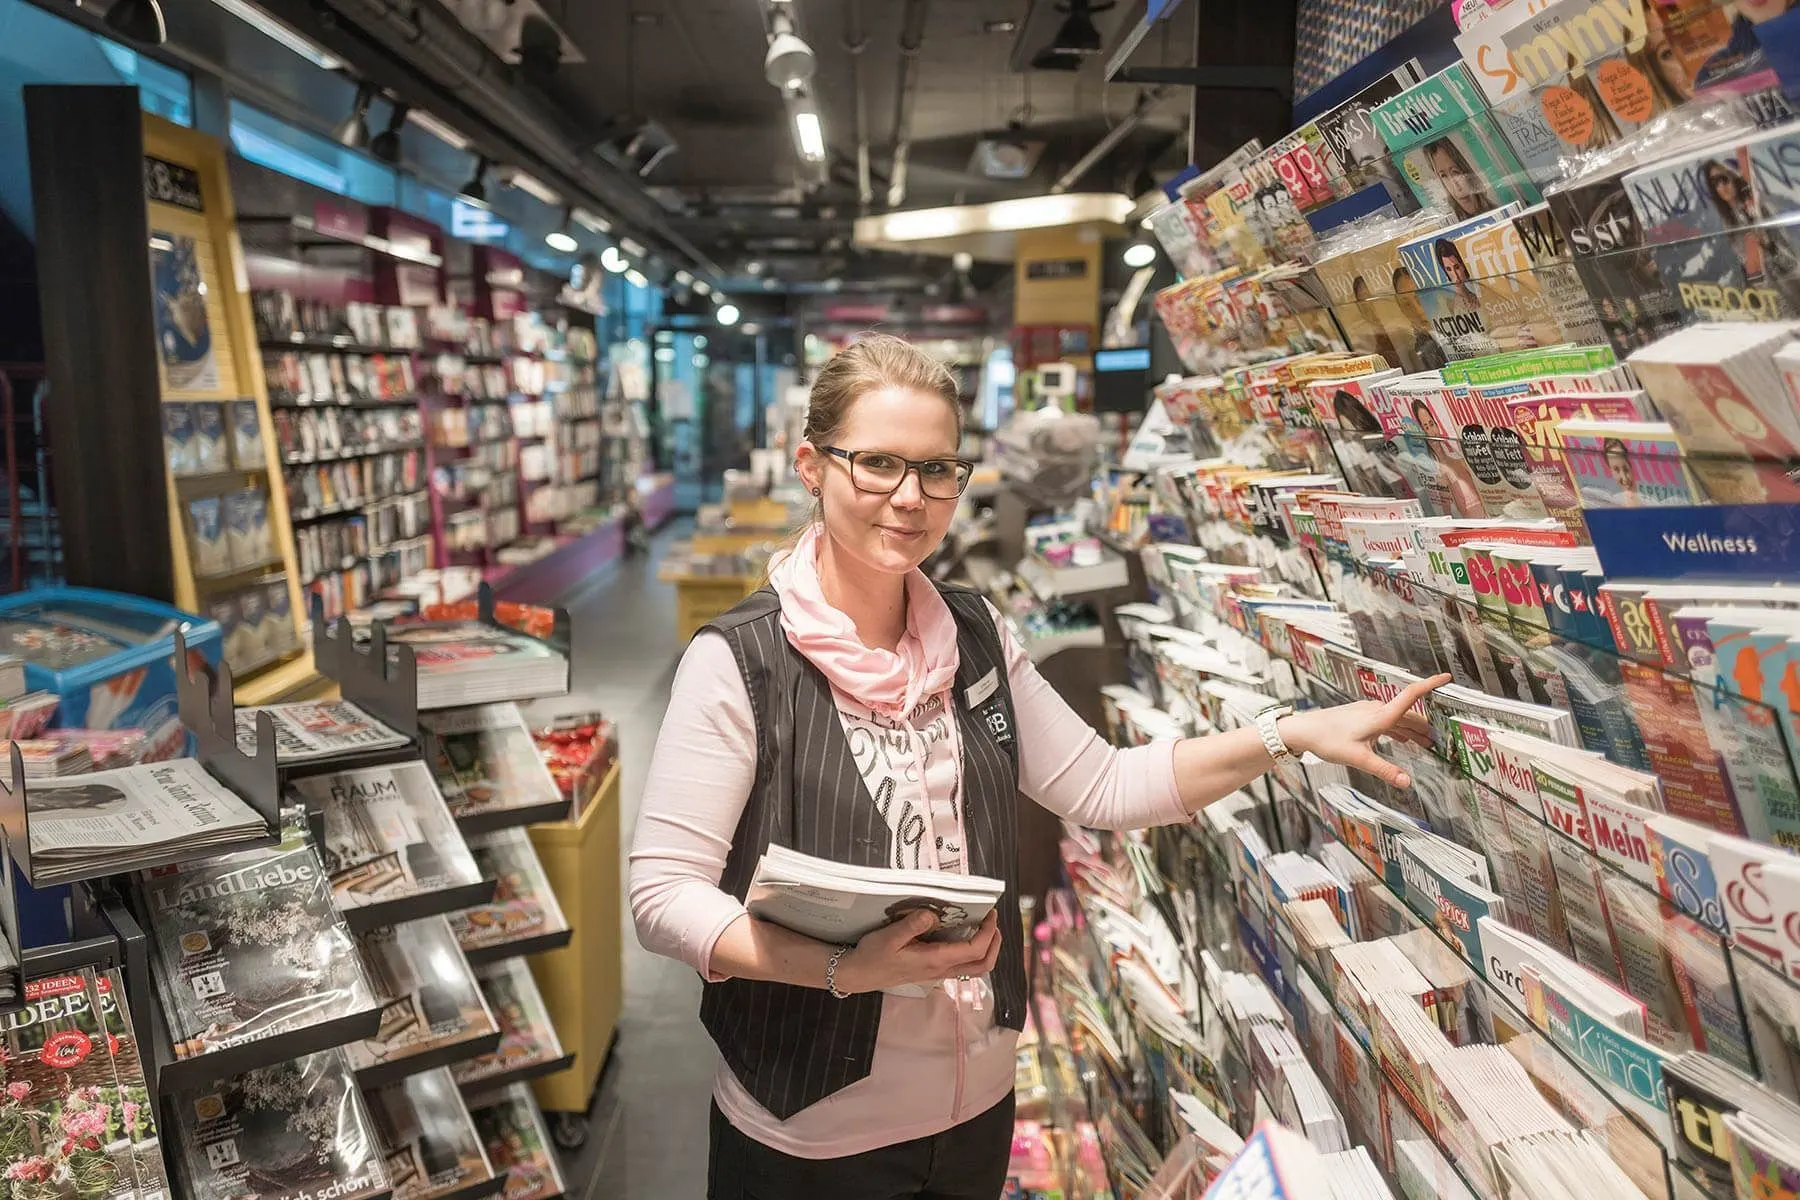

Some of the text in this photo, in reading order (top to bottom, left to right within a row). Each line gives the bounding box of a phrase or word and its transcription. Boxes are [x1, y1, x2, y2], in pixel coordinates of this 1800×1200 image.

[1678, 281, 1780, 322] REBOOT
[1432, 312, 1486, 339] ACTION!
[1492, 434, 1520, 447] Schlank
[1506, 449, 1524, 462] Fett
[1662, 531, 1757, 555] Wellness
[1495, 752, 1537, 794] Mein
[331, 780, 397, 802] RAUM
[1592, 813, 1650, 866] Mein
[154, 860, 312, 910] LandLiebe
[1437, 894, 1470, 932] SPICK
[42, 977, 77, 991] IDEEN
[316, 1175, 370, 1200] schön
